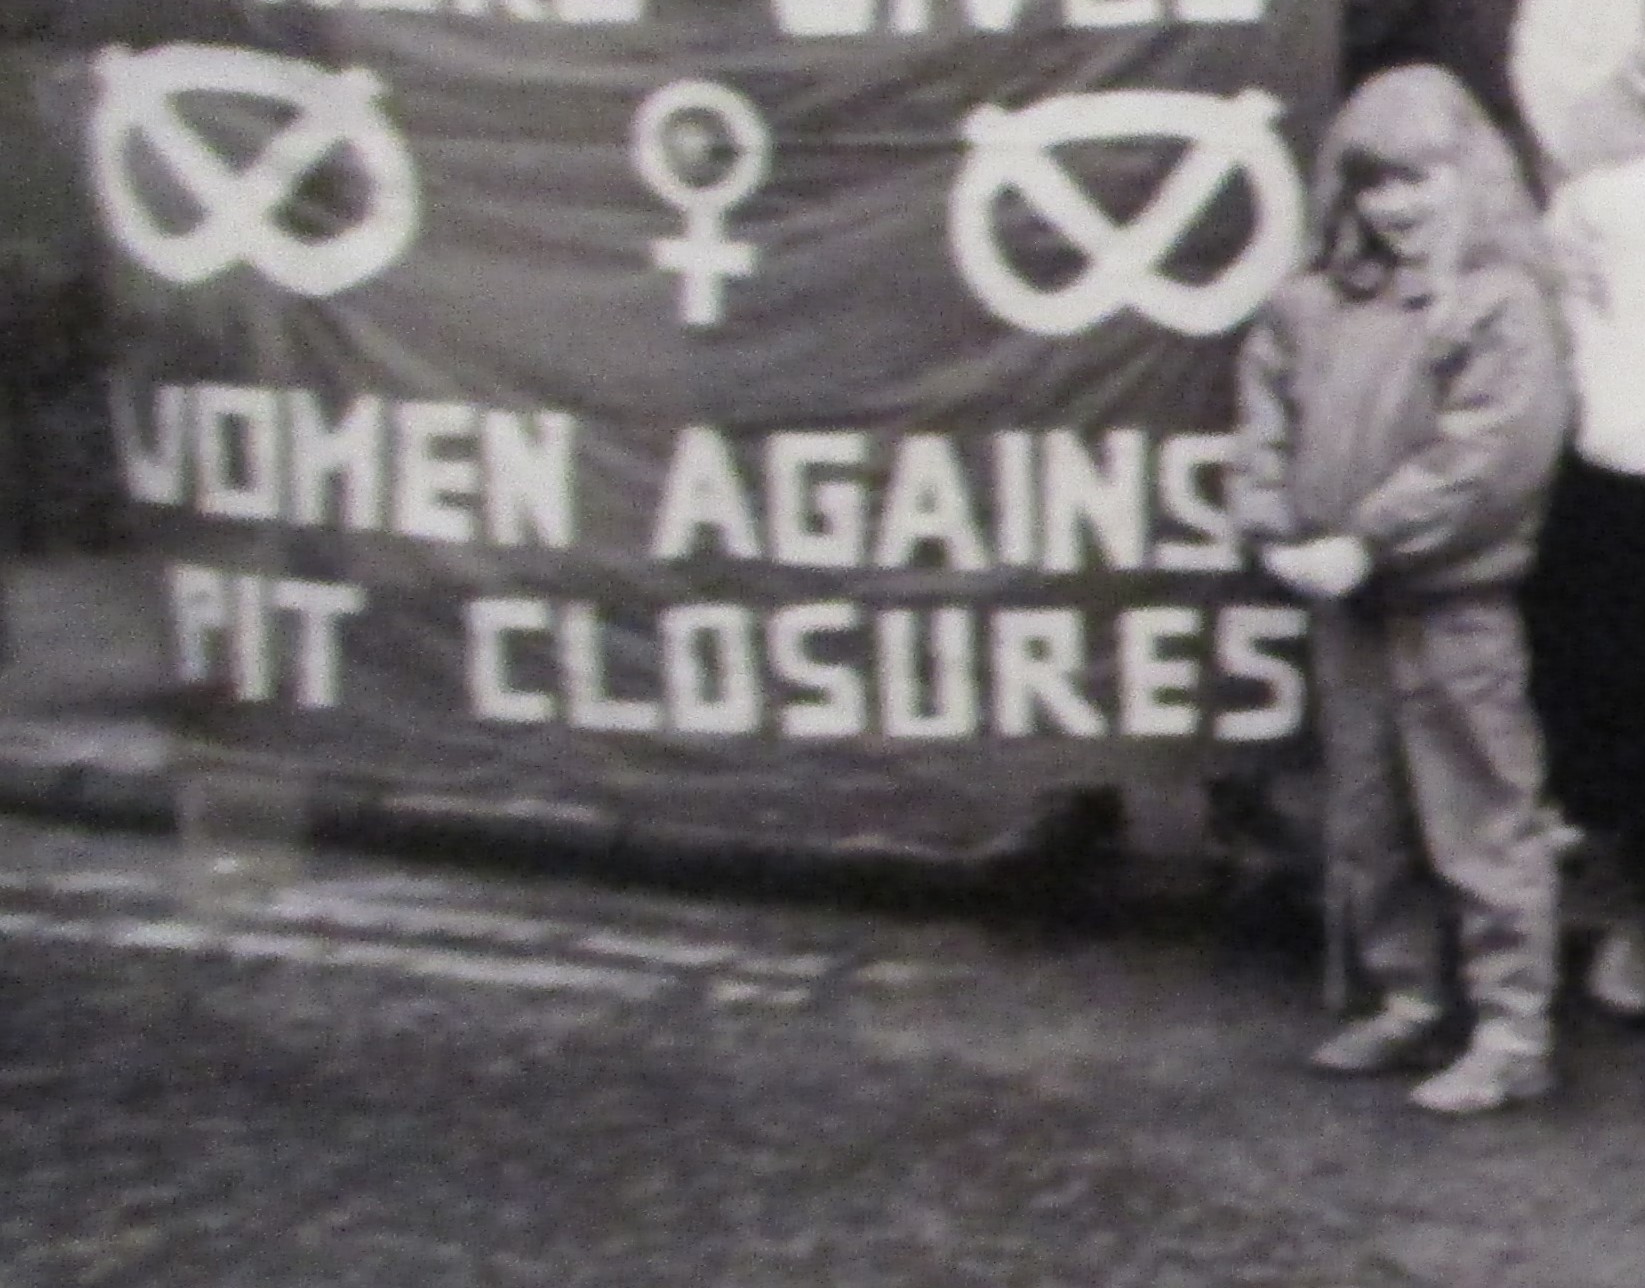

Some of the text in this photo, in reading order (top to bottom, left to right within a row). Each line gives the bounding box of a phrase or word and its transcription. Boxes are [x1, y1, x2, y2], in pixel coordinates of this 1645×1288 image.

[112, 379, 1250, 574] WOMEN AGAINS
[168, 559, 1312, 742] PIT CLOSURES
